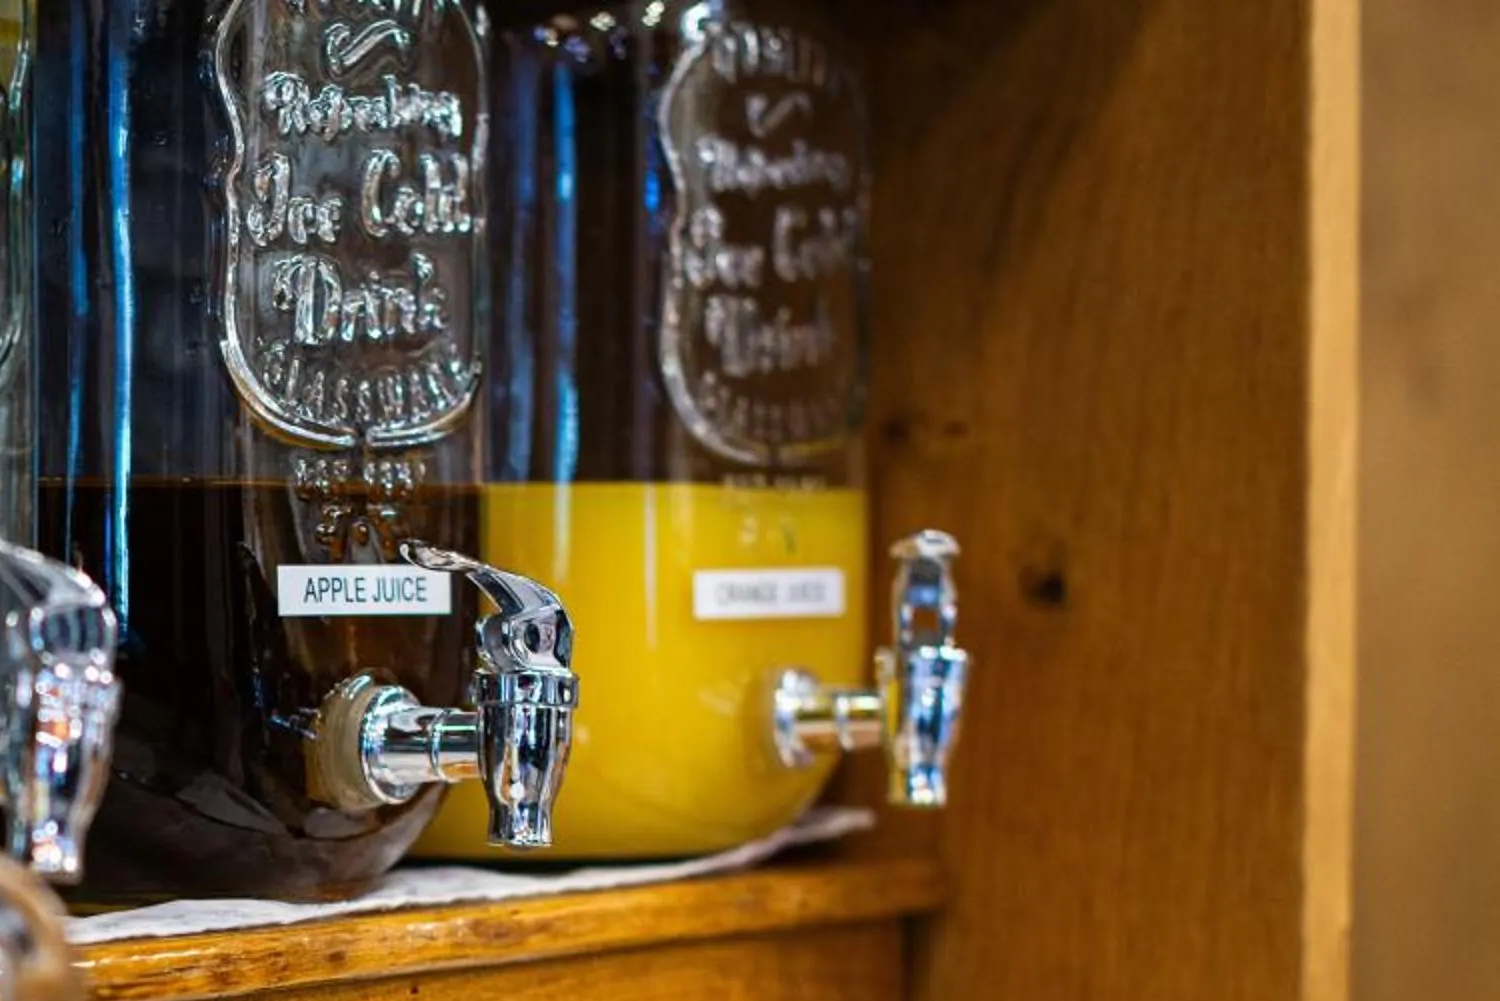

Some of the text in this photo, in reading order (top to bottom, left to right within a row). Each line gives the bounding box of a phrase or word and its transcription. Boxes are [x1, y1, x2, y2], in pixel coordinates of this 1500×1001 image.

[361, 149, 471, 238] Cold
[273, 252, 447, 345] Drink
[303, 577, 427, 603] APPLE JUICE
